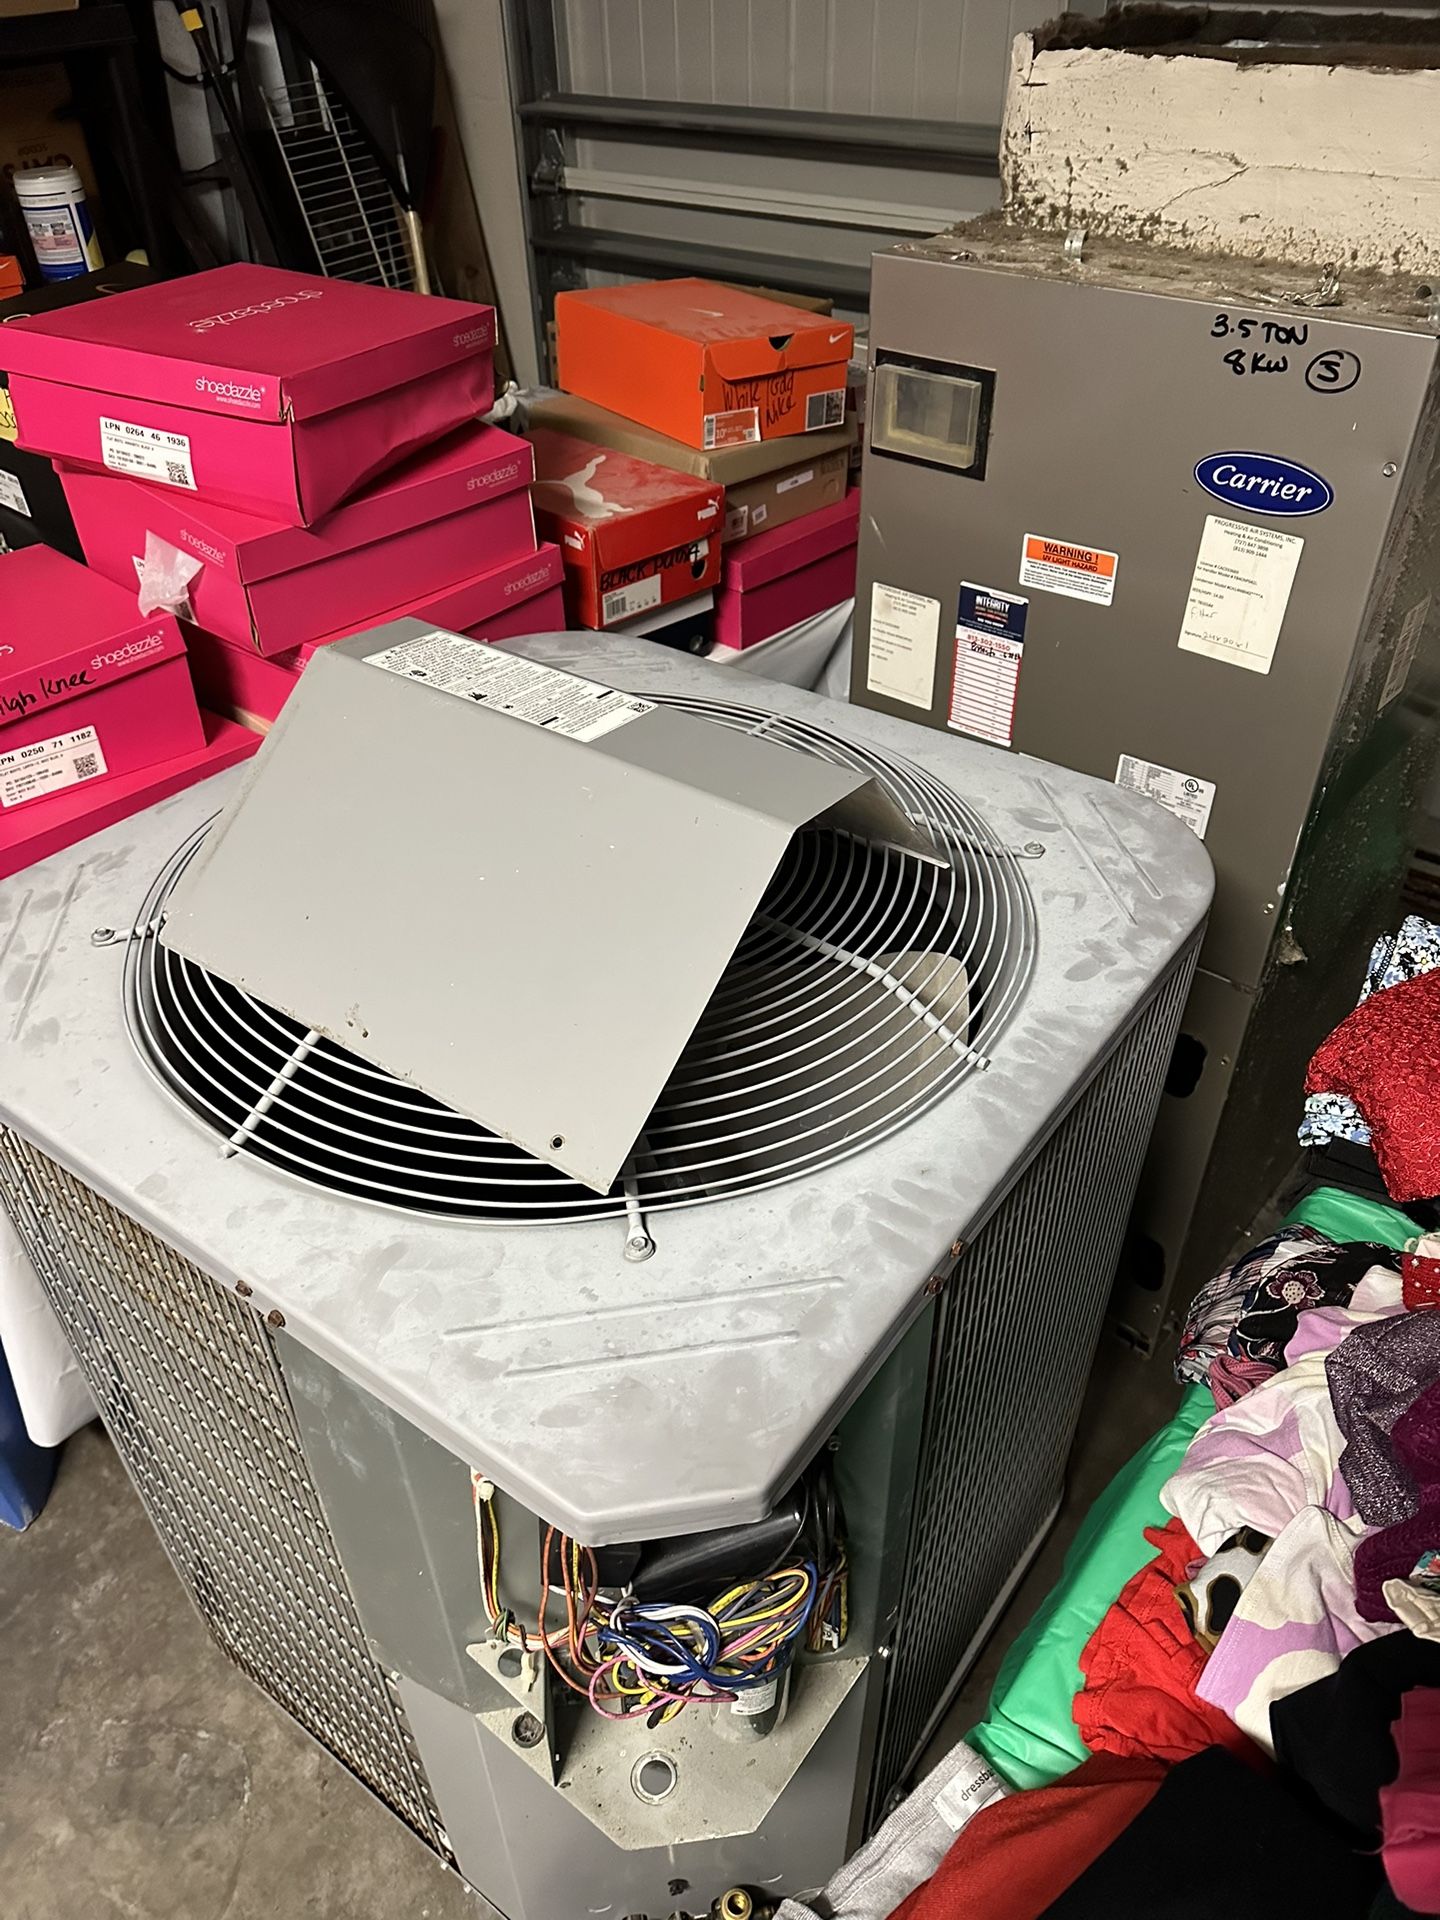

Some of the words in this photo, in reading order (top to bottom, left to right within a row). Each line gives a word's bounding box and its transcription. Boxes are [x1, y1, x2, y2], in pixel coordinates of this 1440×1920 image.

[1211, 313, 1258, 338] 3.5
[1261, 322, 1308, 345] TON
[1223, 349, 1246, 375] 8
[195, 376, 262, 402] shoedazzle
[105, 421, 121, 431] LPN
[125, 426, 145, 437] 0264
[151, 433, 161, 442] 46
[166, 436, 186, 447] 1936
[1212, 464, 1313, 503] Carrier
[1215, 518, 1248, 532] PROGRESSIVE
[1251, 527, 1259, 535] AIR
[1042, 554, 1051, 562] UV
[1052, 556, 1070, 565] LIGHT
[1071, 561, 1098, 572] HAZARD
[1043, 542, 1093, 562] WARNING
[976, 594, 1009, 613] INTEGRITY
[91, 635, 162, 670] shoedazzle
[0, 755, 15, 766] PN
[20, 745, 45, 759] 0250
[51, 739, 63, 749] 71
[70, 730, 92, 743] 1182
